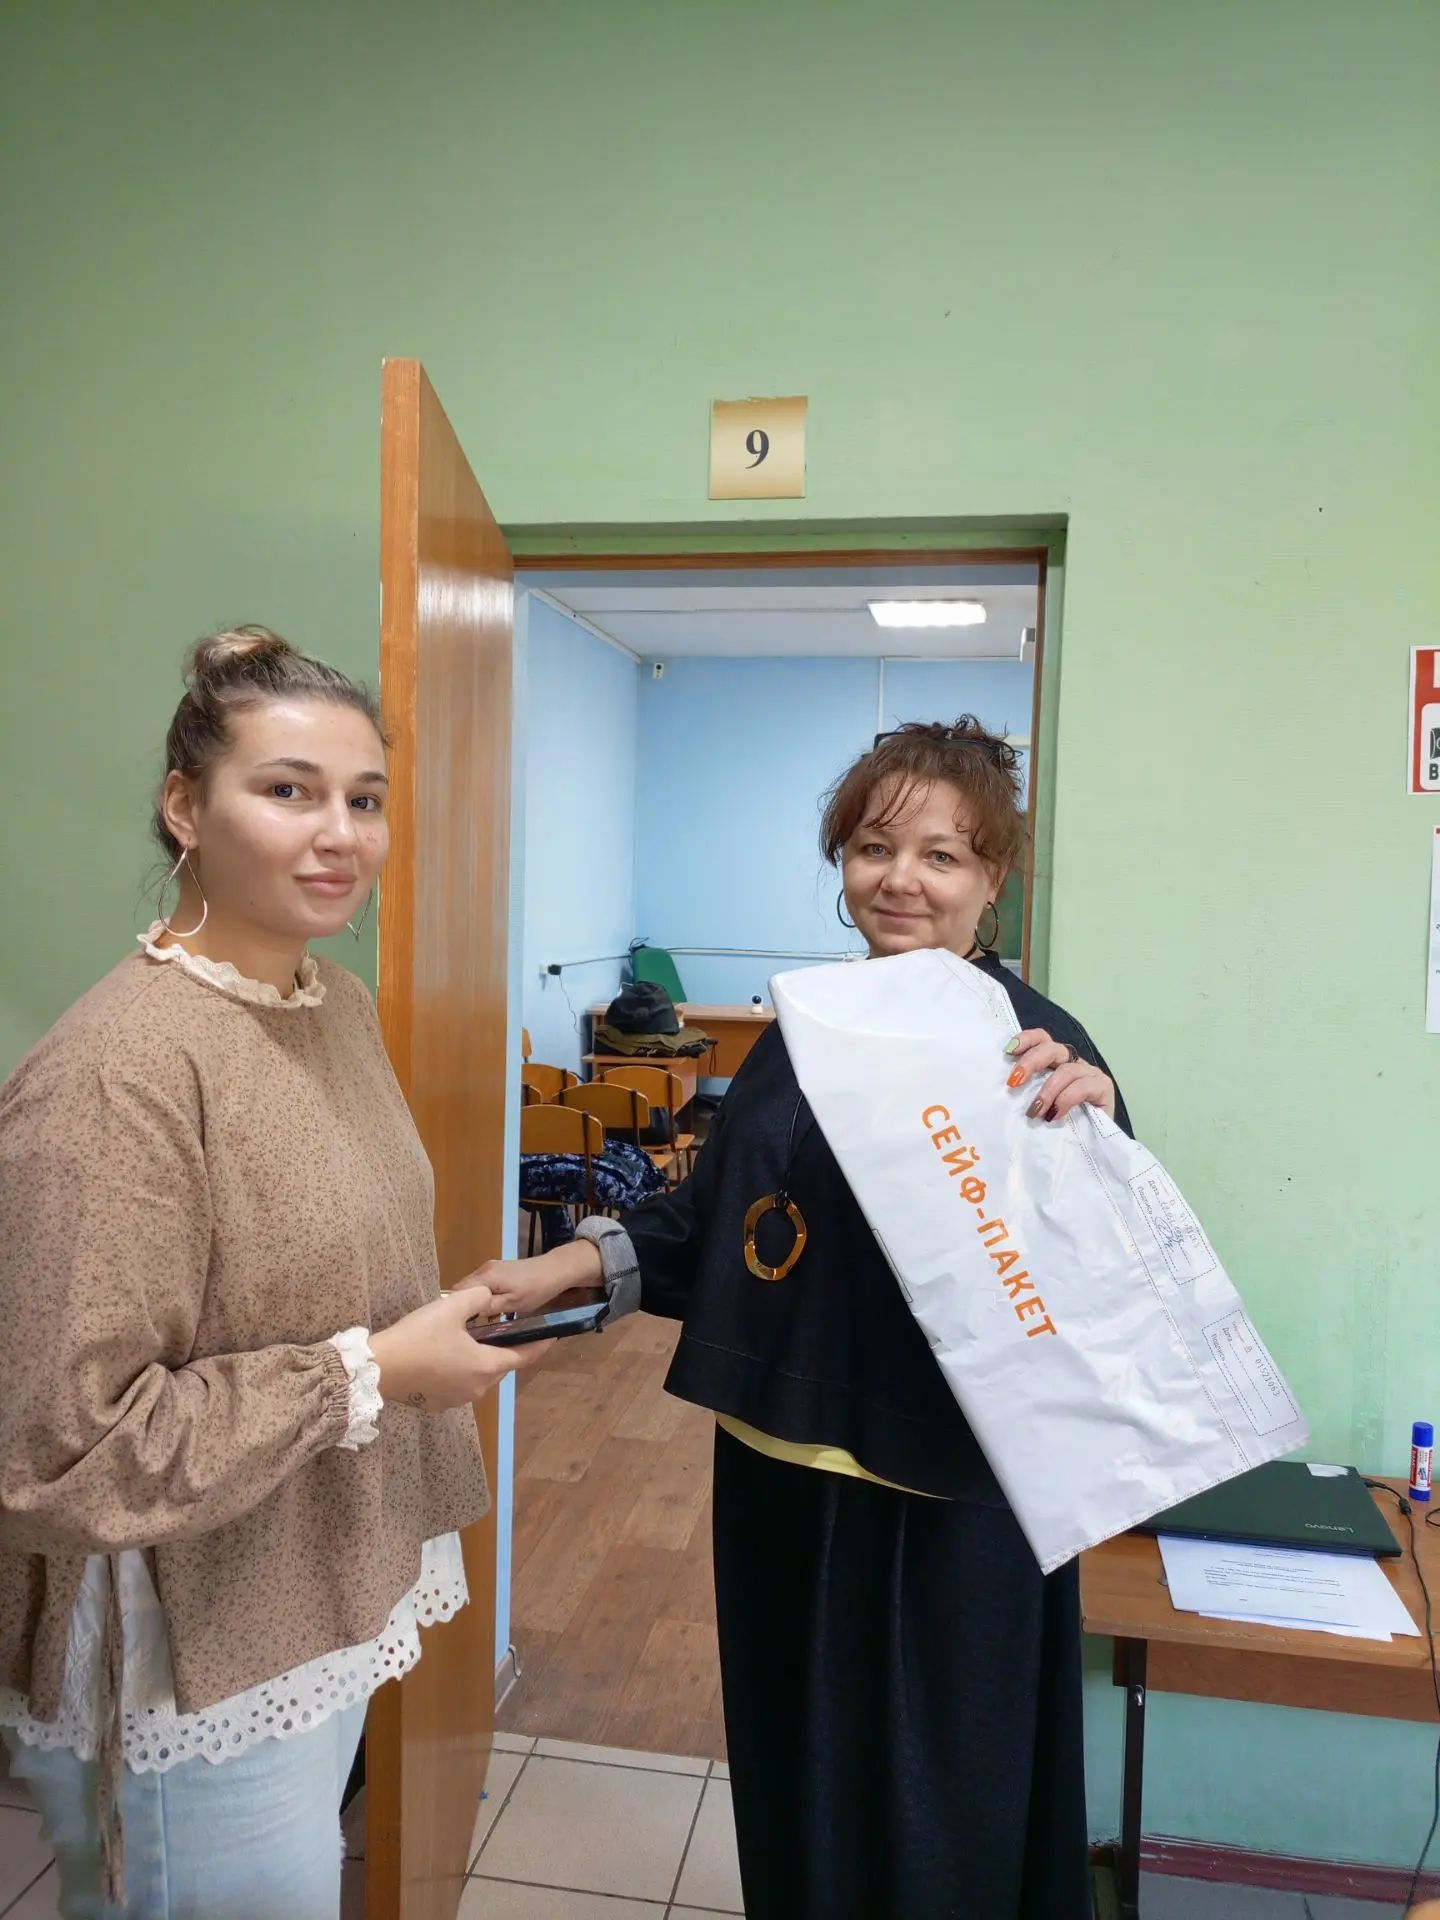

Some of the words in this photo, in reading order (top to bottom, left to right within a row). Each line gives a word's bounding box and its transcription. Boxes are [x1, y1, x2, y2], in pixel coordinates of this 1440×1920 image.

[745, 429, 769, 469] 9
[921, 1104, 1058, 1338] СЕЙФ-ПАКЕТ
[1304, 1523, 1354, 1533] Lenovo
